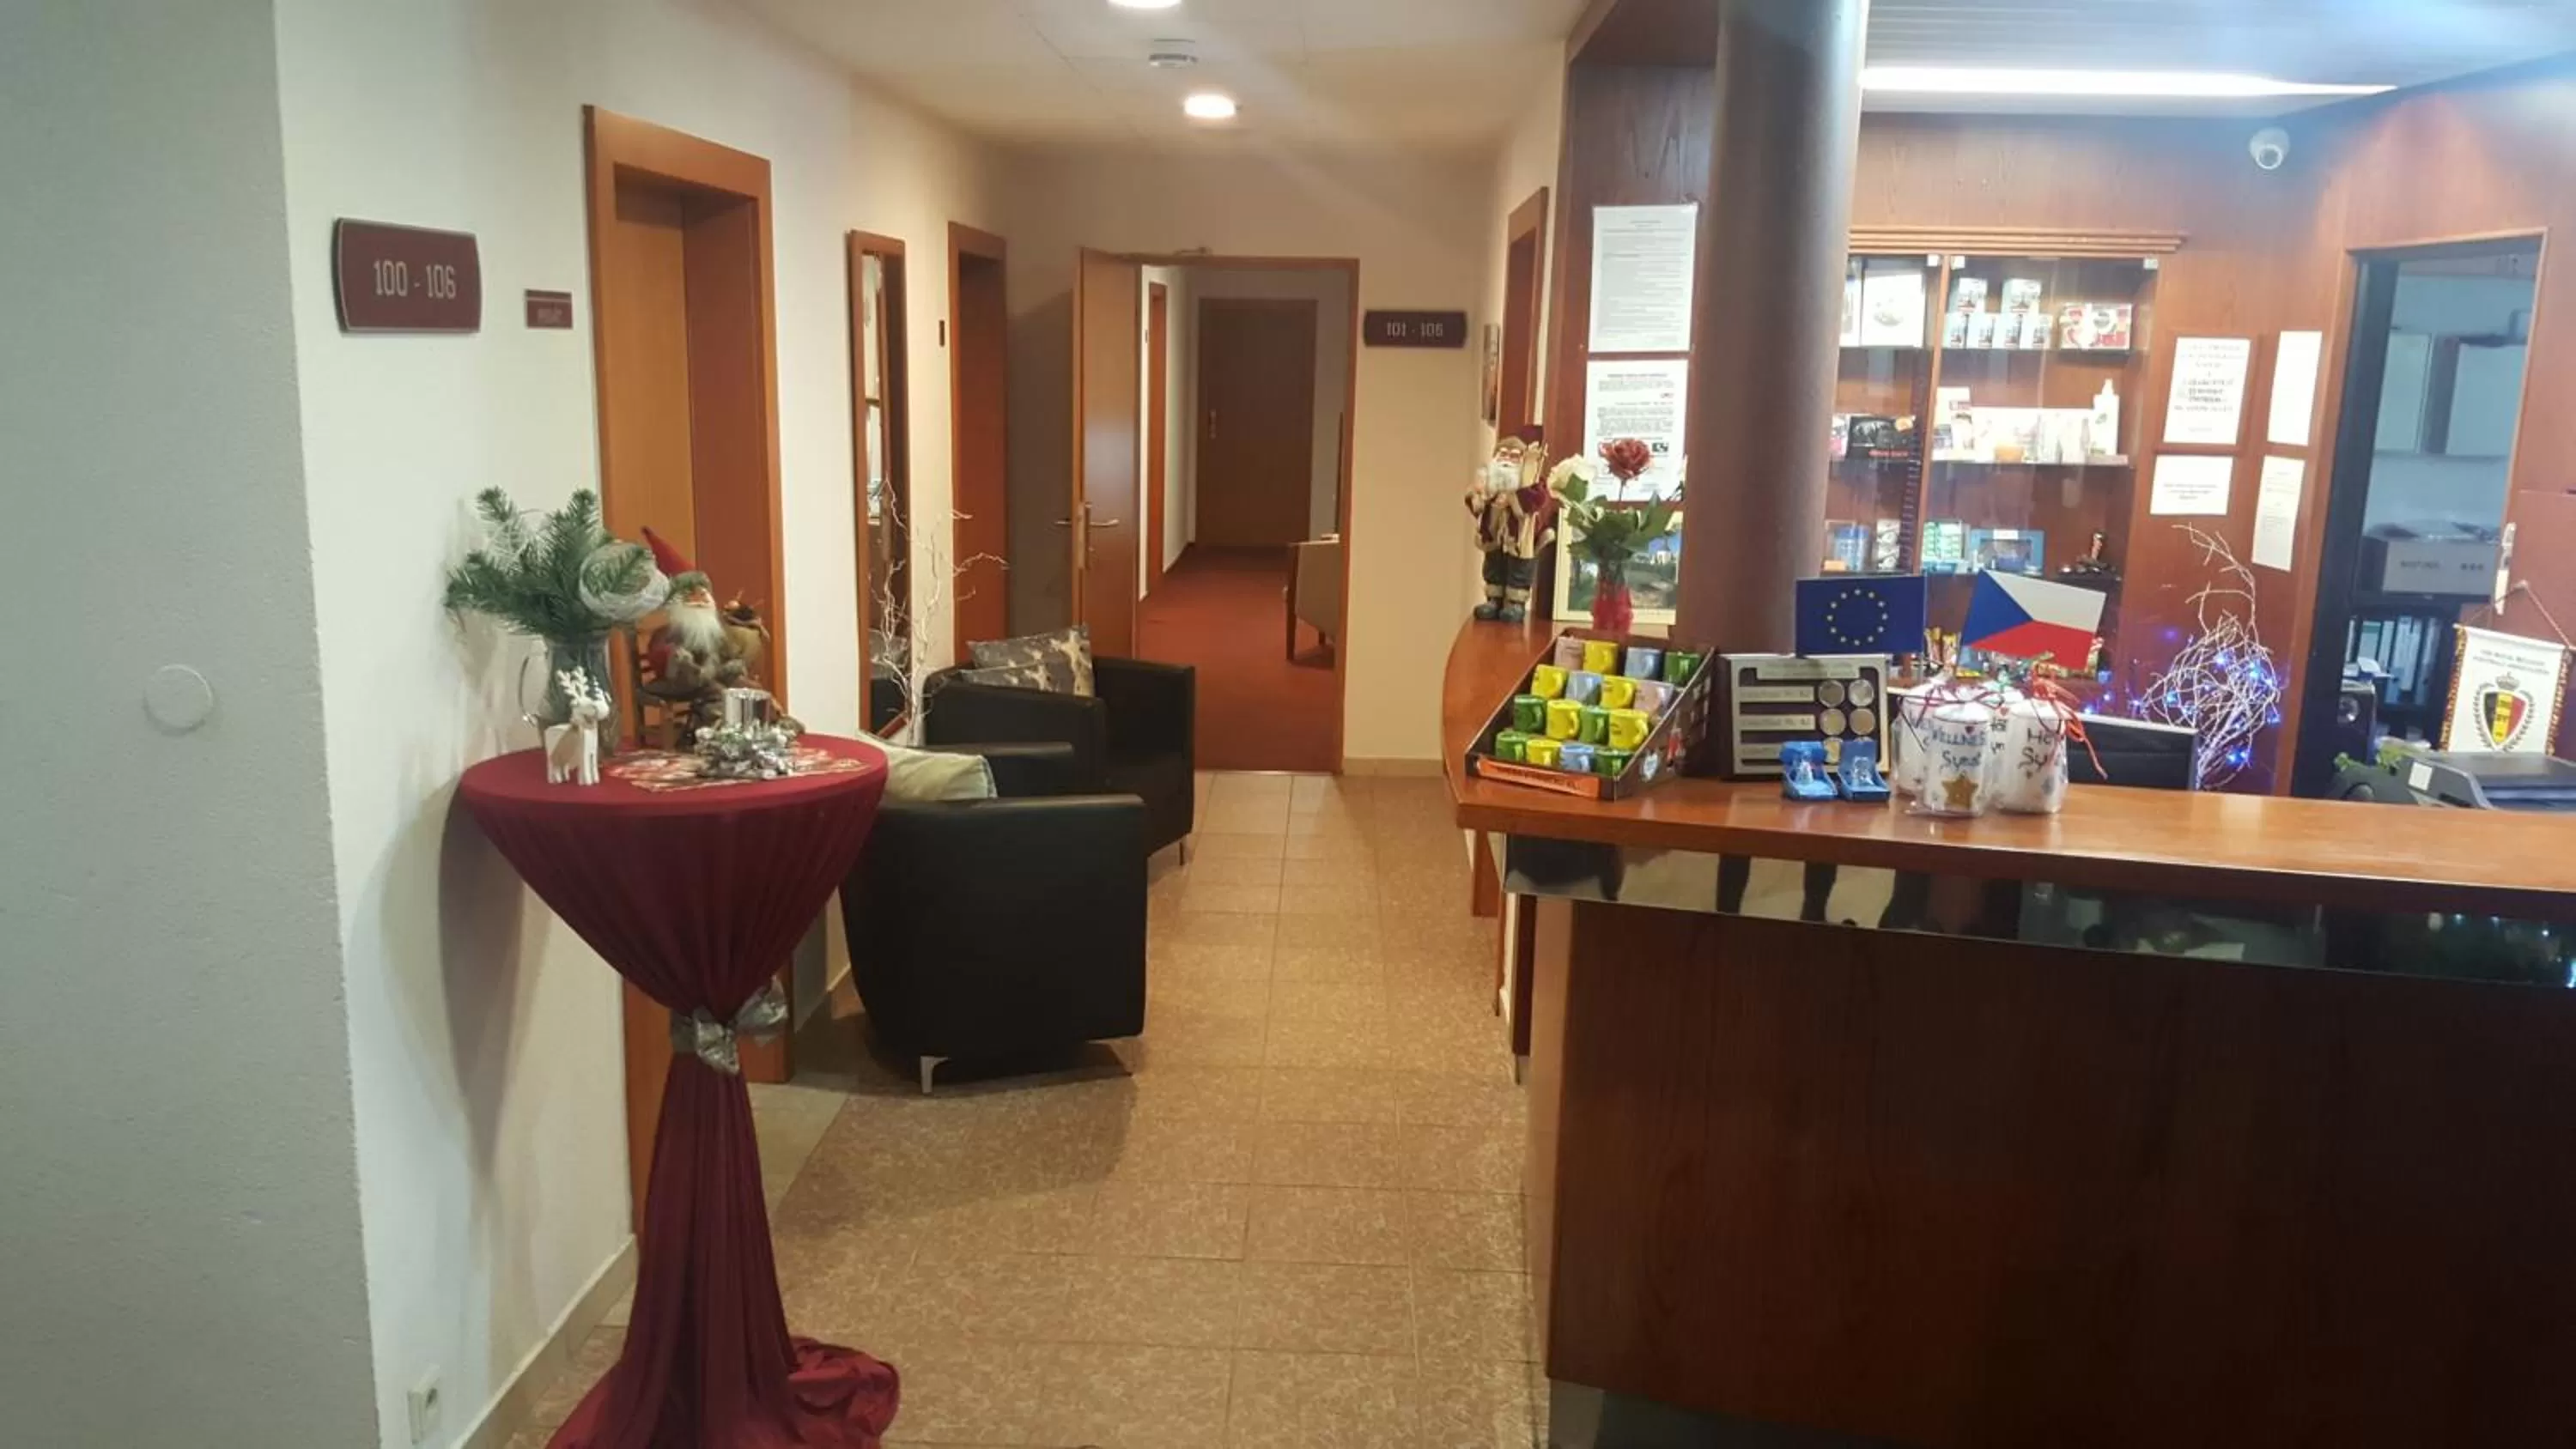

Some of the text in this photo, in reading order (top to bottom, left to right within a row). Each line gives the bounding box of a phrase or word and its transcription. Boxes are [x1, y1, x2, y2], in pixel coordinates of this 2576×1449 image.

[374, 260, 408, 297] 100
[426, 264, 457, 300] 106
[1387, 321, 1406, 337] 101
[1420, 322, 1444, 337] 106
